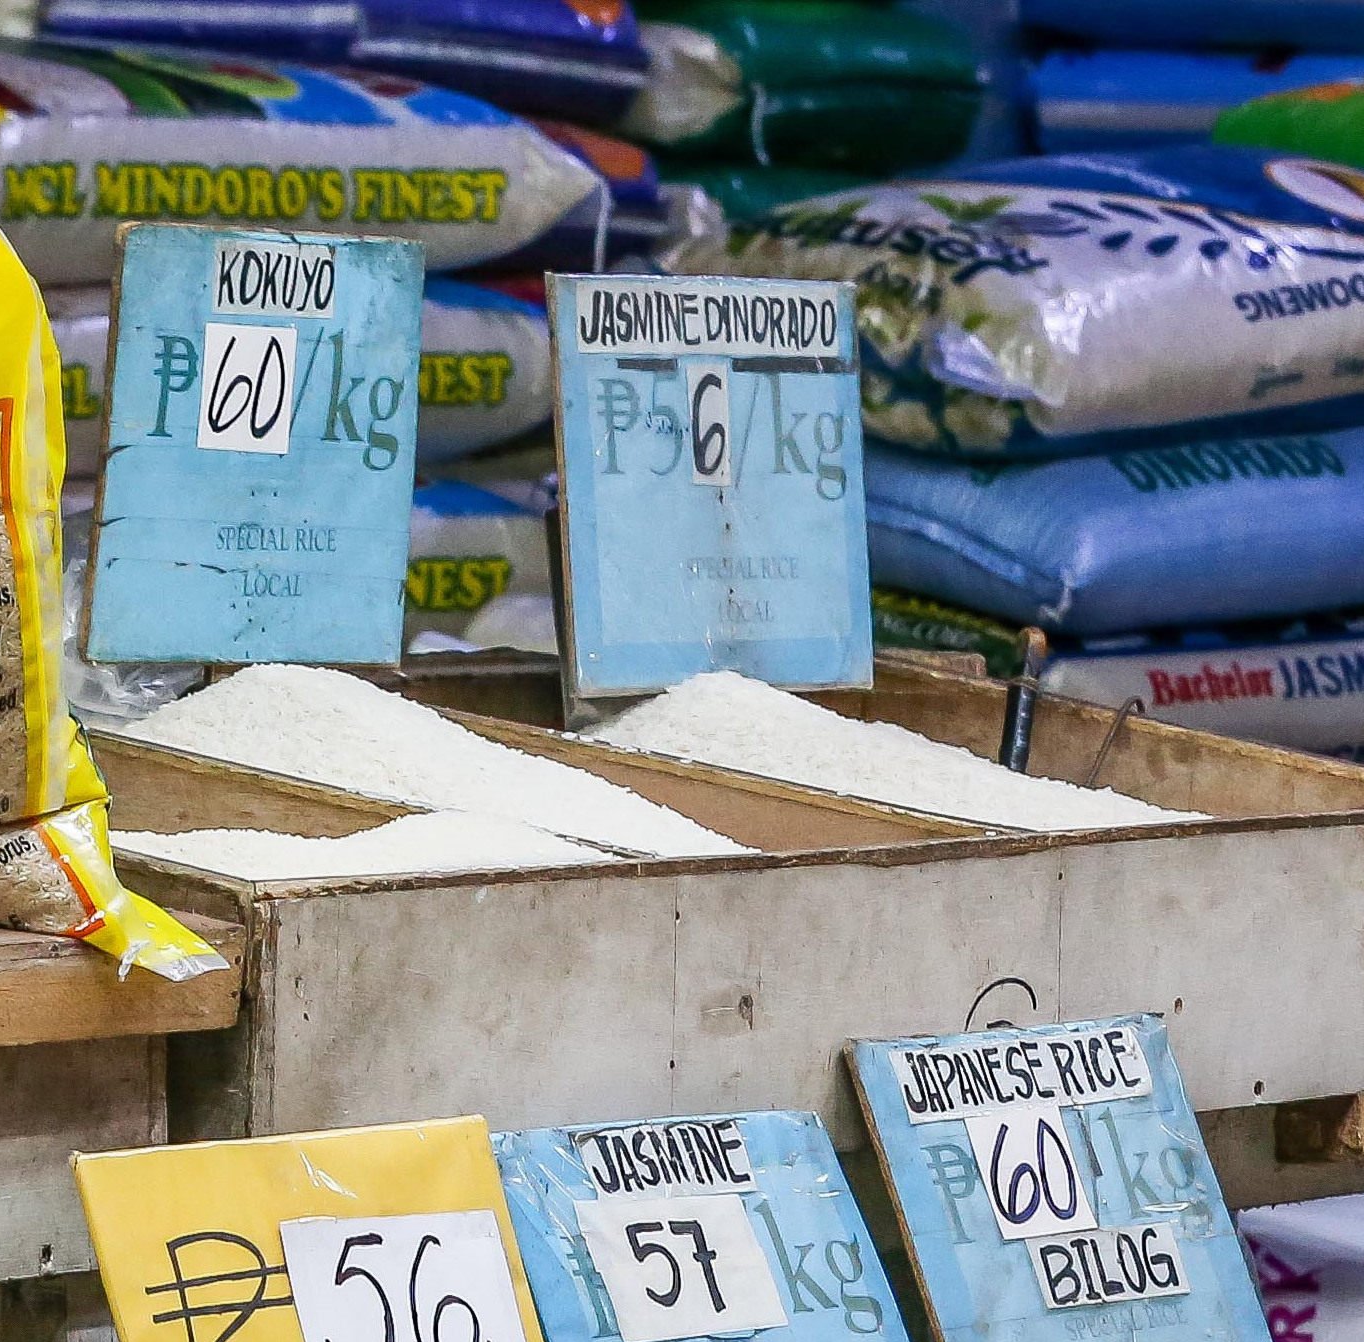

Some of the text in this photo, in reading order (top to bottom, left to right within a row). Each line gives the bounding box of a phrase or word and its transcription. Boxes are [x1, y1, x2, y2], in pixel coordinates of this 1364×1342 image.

[92, 160, 344, 221] MINDORO'S
[353, 168, 508, 222] FINEST
[218, 250, 334, 313] KOKUYO
[580, 289, 837, 349] JASMINE DINORADO
[216, 524, 337, 553] SPECIAL RICE
[241, 572, 302, 598] LOCAL
[1146, 661, 1274, 707] Bachelor
[902, 1030, 1141, 1113] JAPANESE RICE
[591, 1121, 751, 1195] JASMINE
[1038, 1232, 1180, 1306] BILOG
